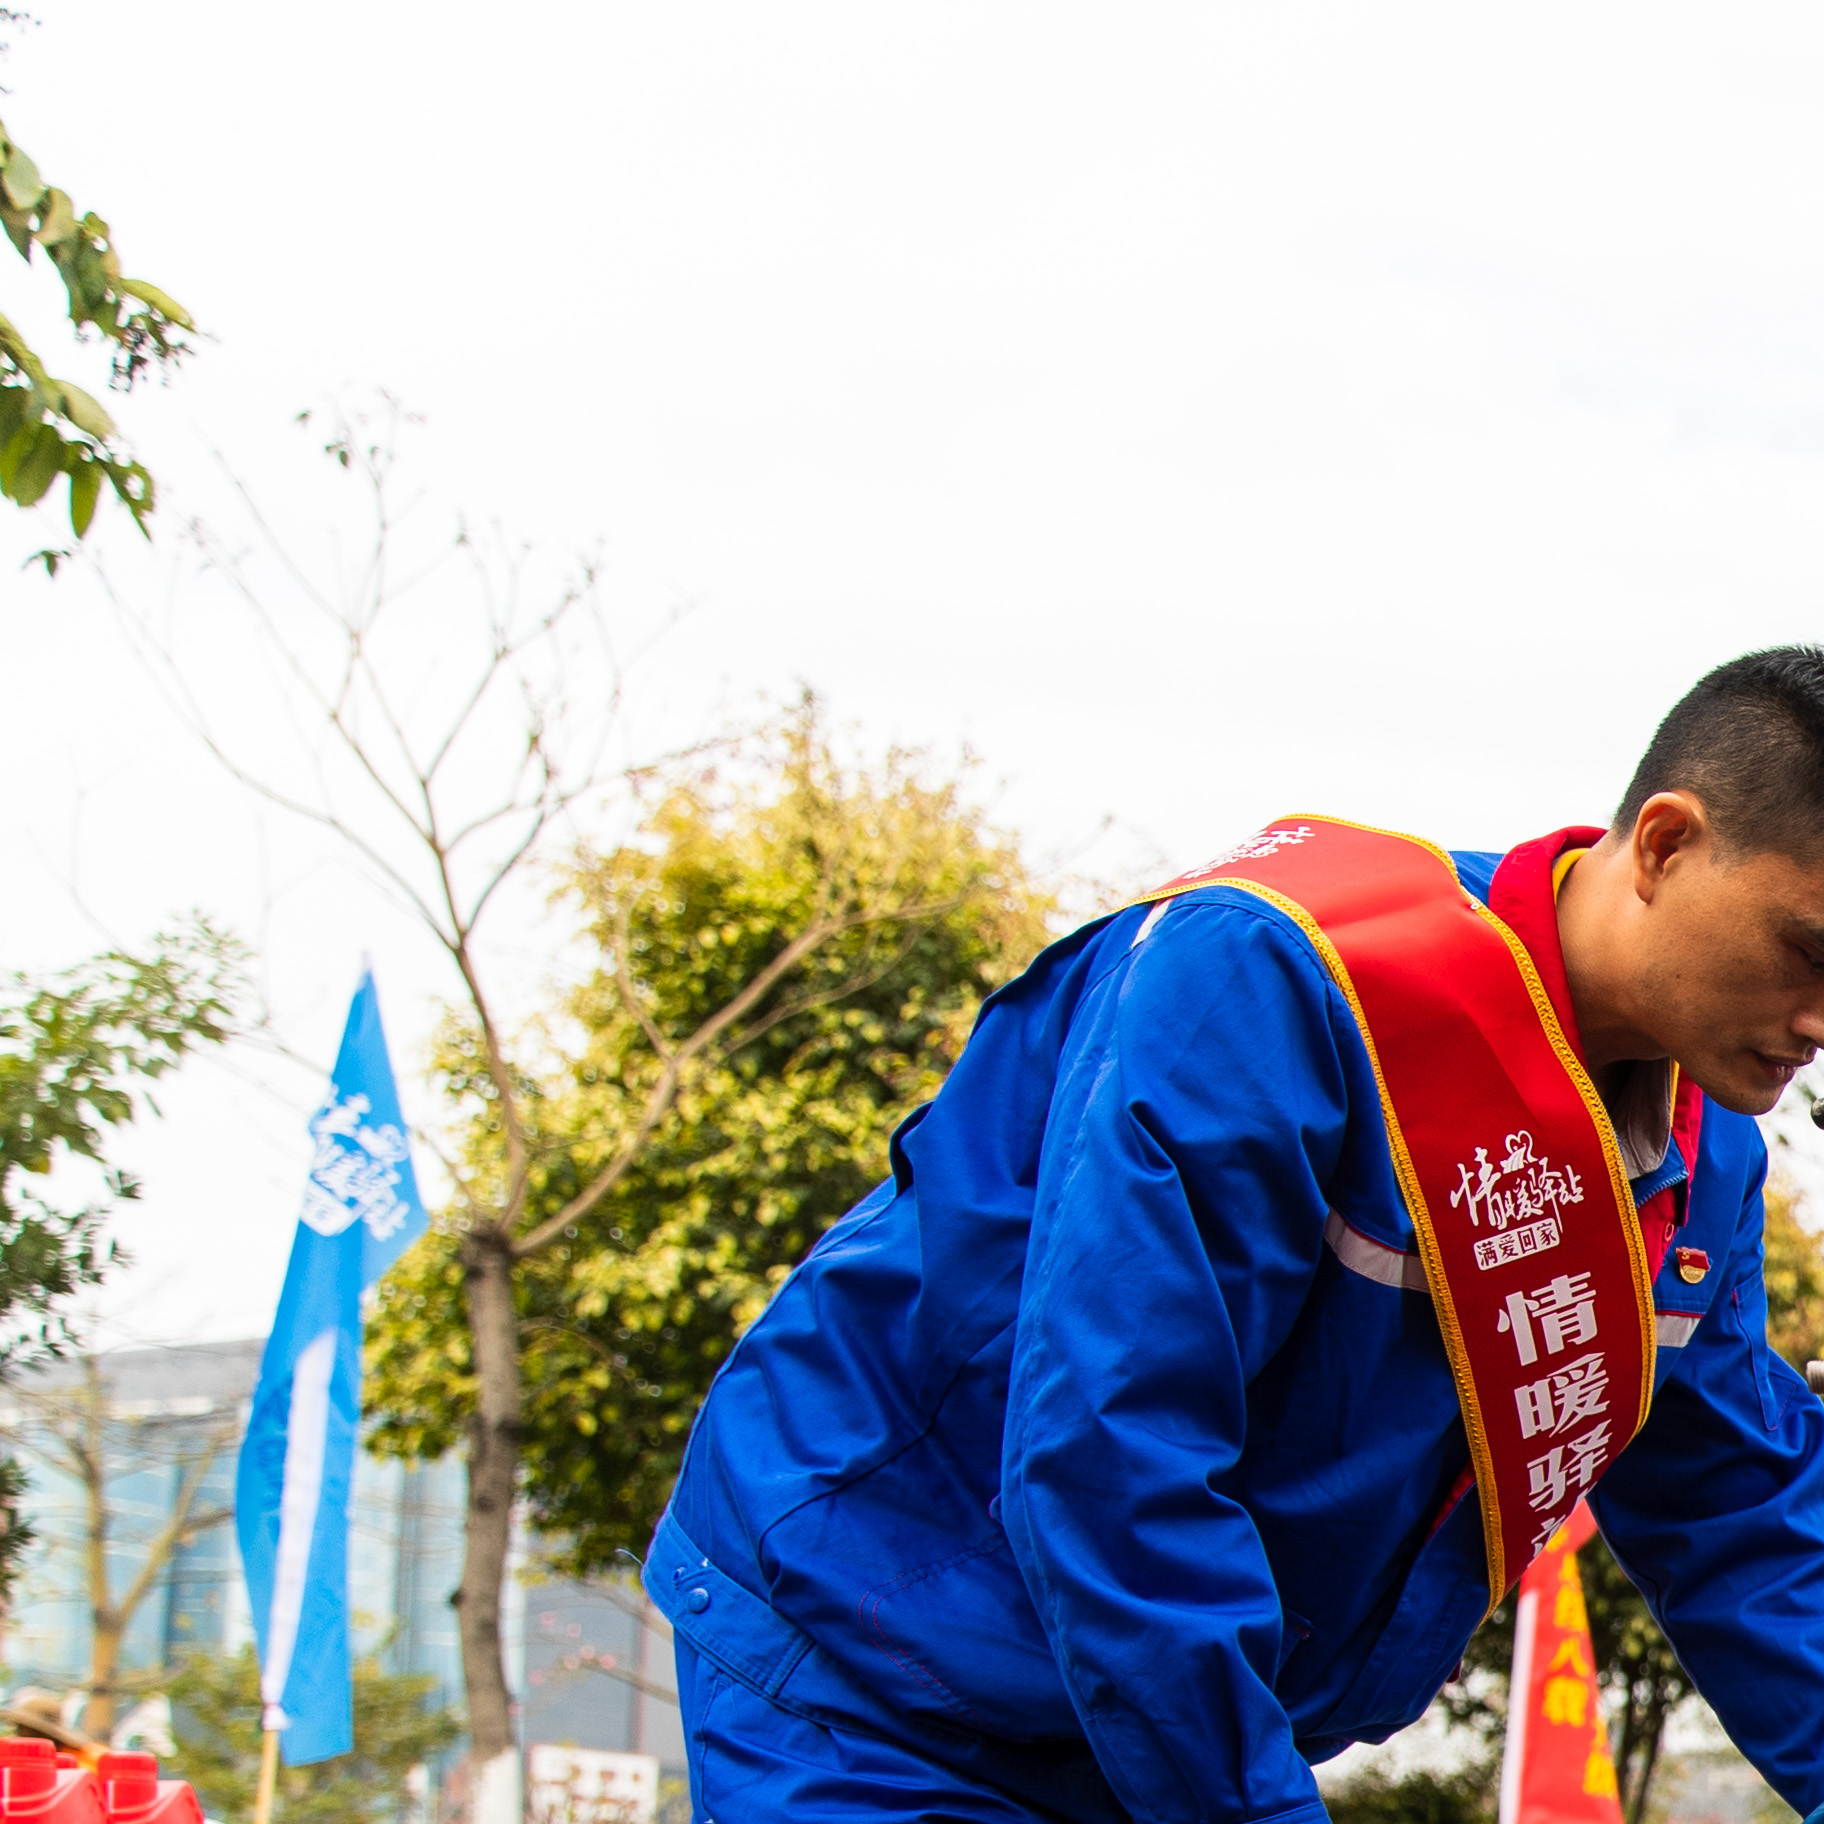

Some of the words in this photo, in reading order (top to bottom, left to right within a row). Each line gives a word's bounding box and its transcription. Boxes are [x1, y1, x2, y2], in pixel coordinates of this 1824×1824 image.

[1450, 1147, 1584, 1233] 情暖驿站
[1477, 1222, 1558, 1266] 满爱回家
